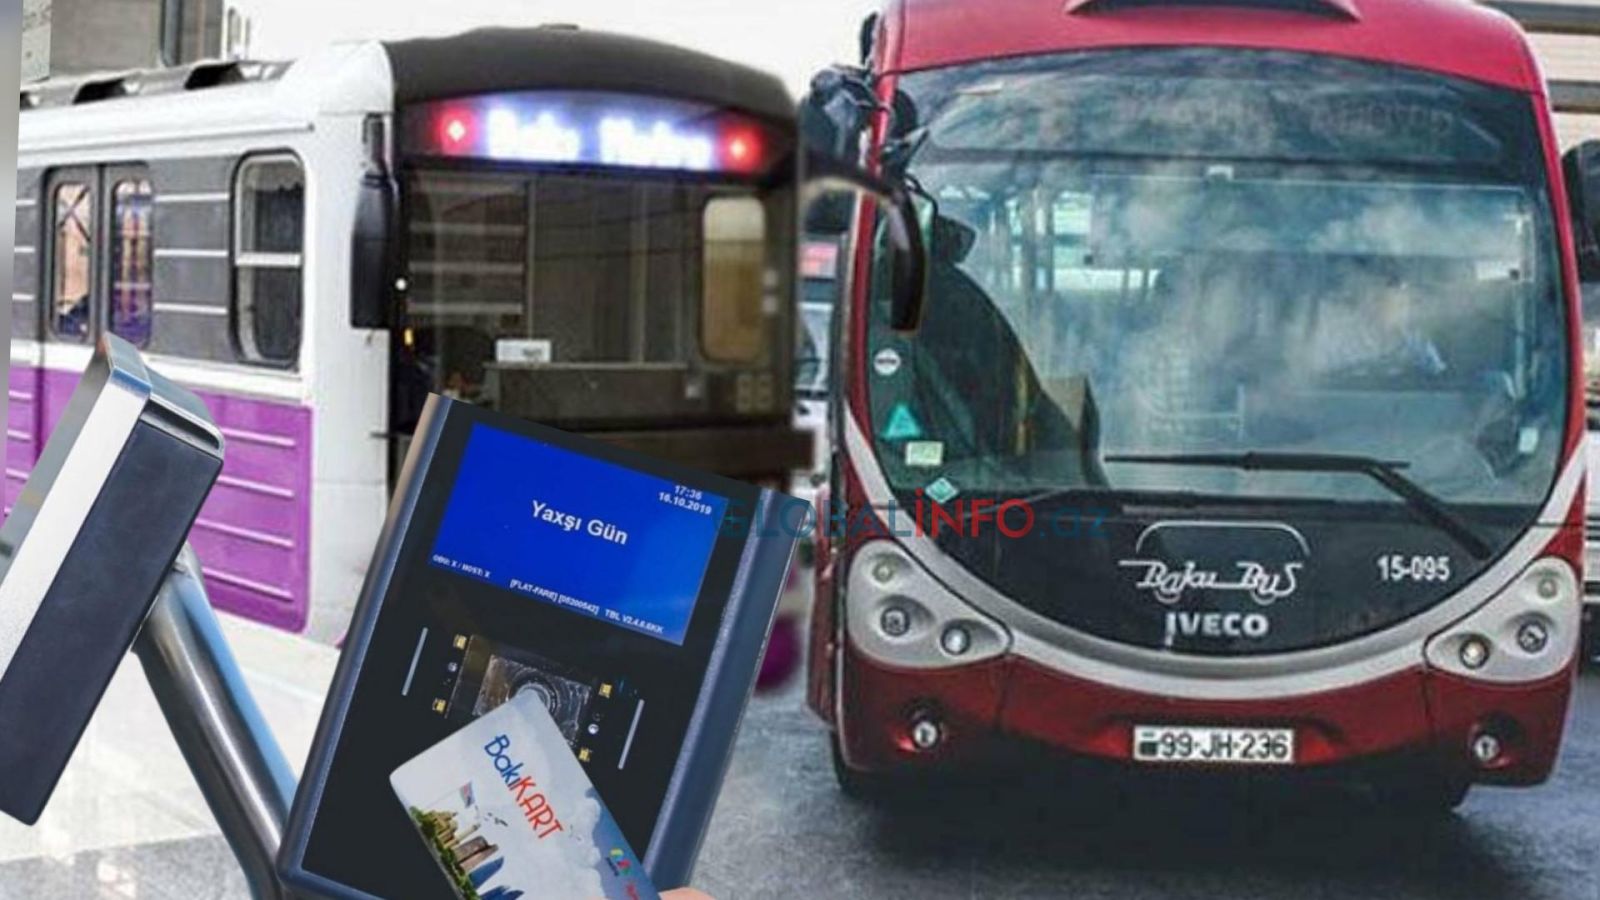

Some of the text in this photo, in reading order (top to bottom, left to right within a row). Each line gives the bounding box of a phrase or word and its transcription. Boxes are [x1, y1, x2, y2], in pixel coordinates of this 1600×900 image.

[658, 491, 712, 515] 16.10.2019
[674, 485, 702, 500] 17:36
[532, 500, 628, 545] Yaxşı Gün
[1377, 555, 1451, 581] 15-095
[1166, 612, 1269, 642] IVECO
